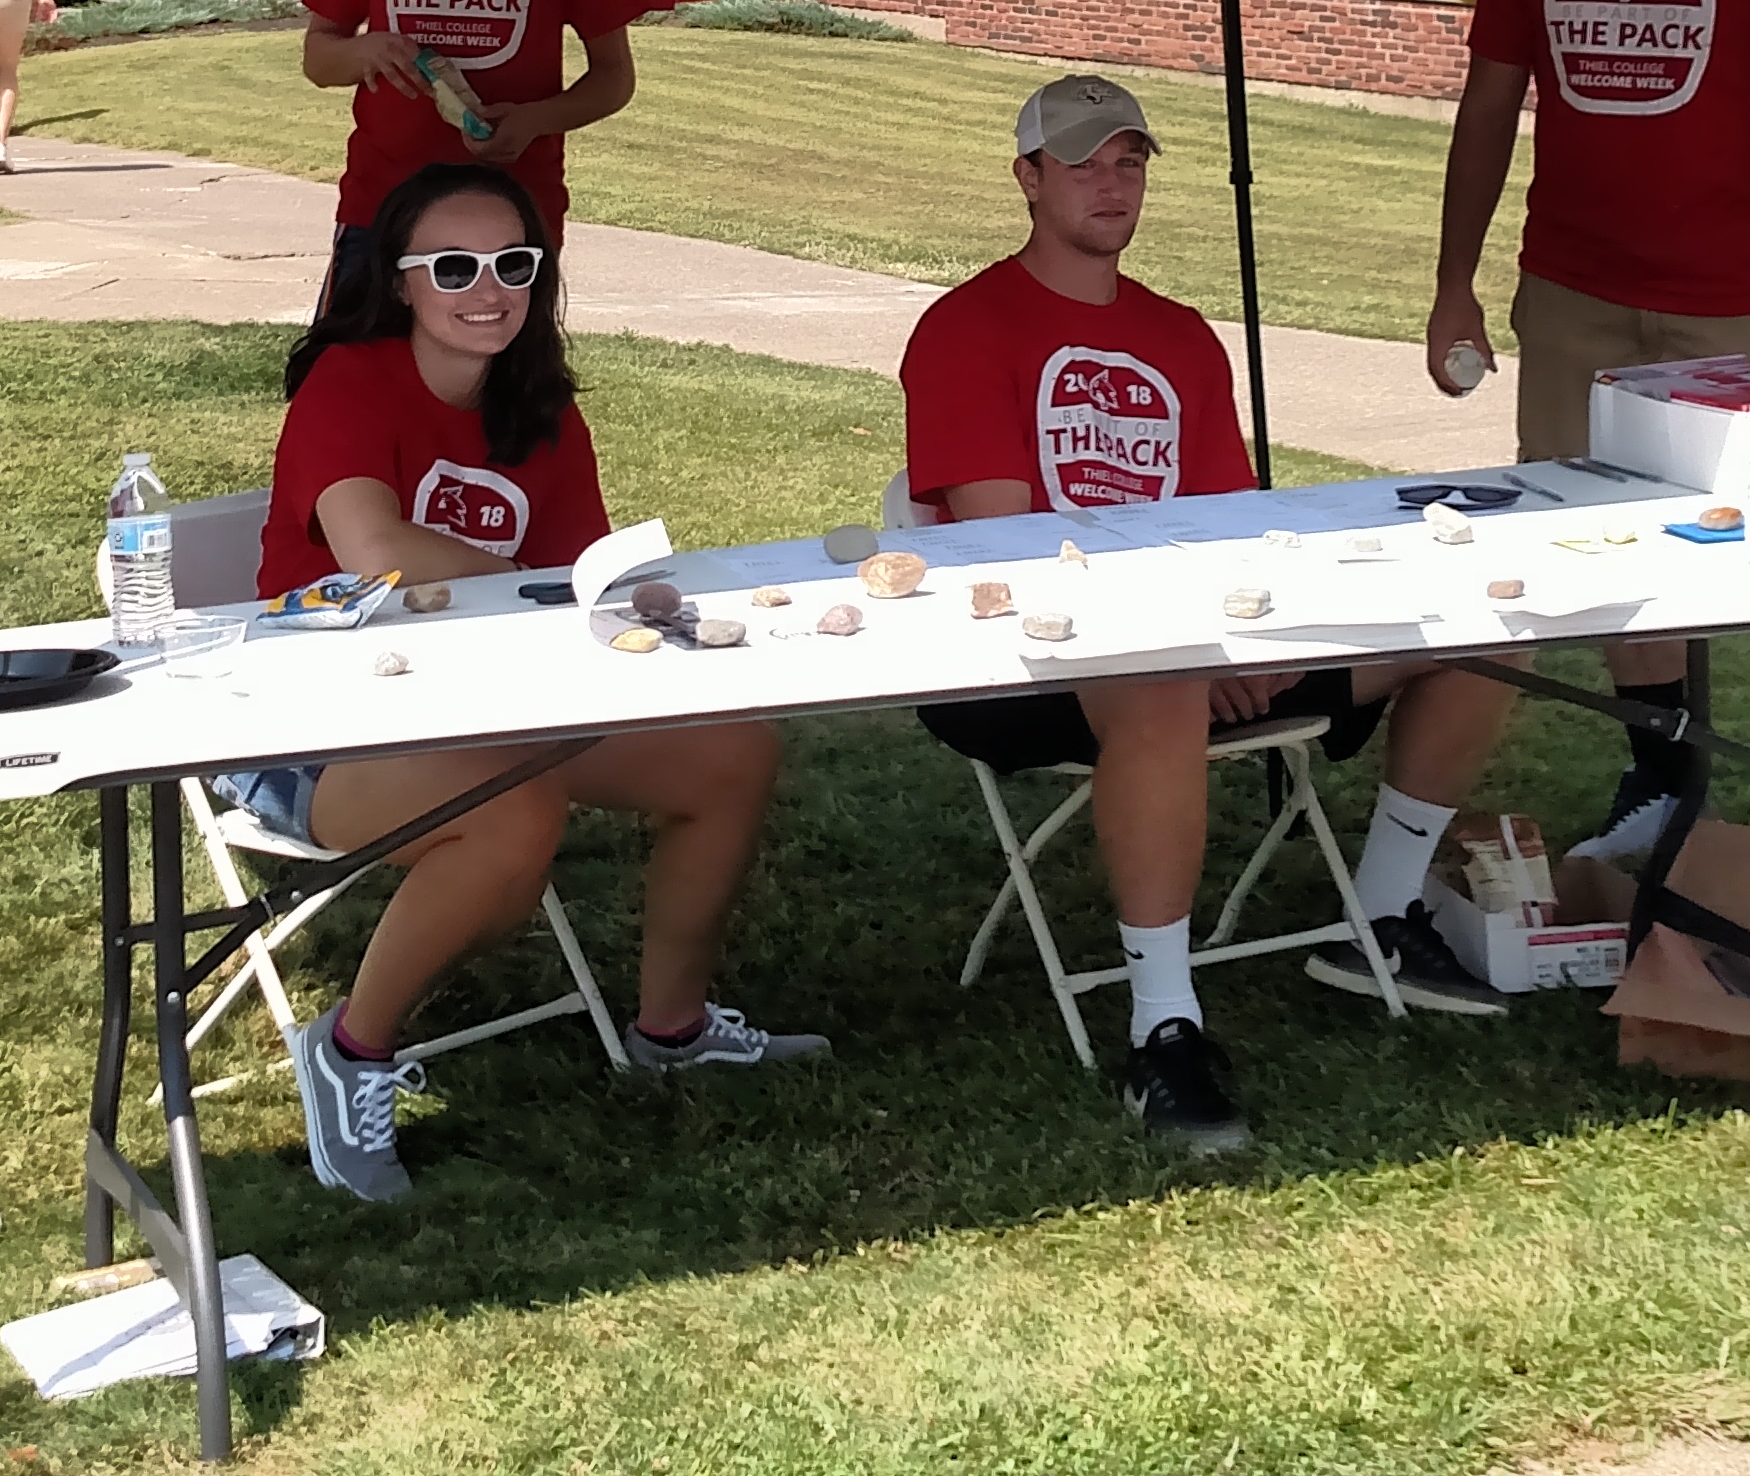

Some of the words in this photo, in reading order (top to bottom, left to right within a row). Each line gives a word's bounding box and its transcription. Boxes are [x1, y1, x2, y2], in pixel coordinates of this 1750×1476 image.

[1597, 6, 1651, 20] PART
[415, 21, 443, 31] THIEL
[446, 22, 491, 33] COLLEGE
[466, 35, 501, 47] WEEK
[1550, 20, 1608, 45] THE
[1618, 23, 1706, 51] PACK
[1578, 60, 1609, 72] THIEL
[1612, 61, 1665, 74] COLLEGE
[1570, 75, 1633, 88] WELCOME
[1635, 77, 1675, 90] WEEK
[1126, 385, 1153, 405] 18
[1062, 408, 1086, 424] BE
[1134, 422, 1161, 436] OF
[479, 506, 505, 527] 18
[5, 754, 53, 767] LIFETIME
